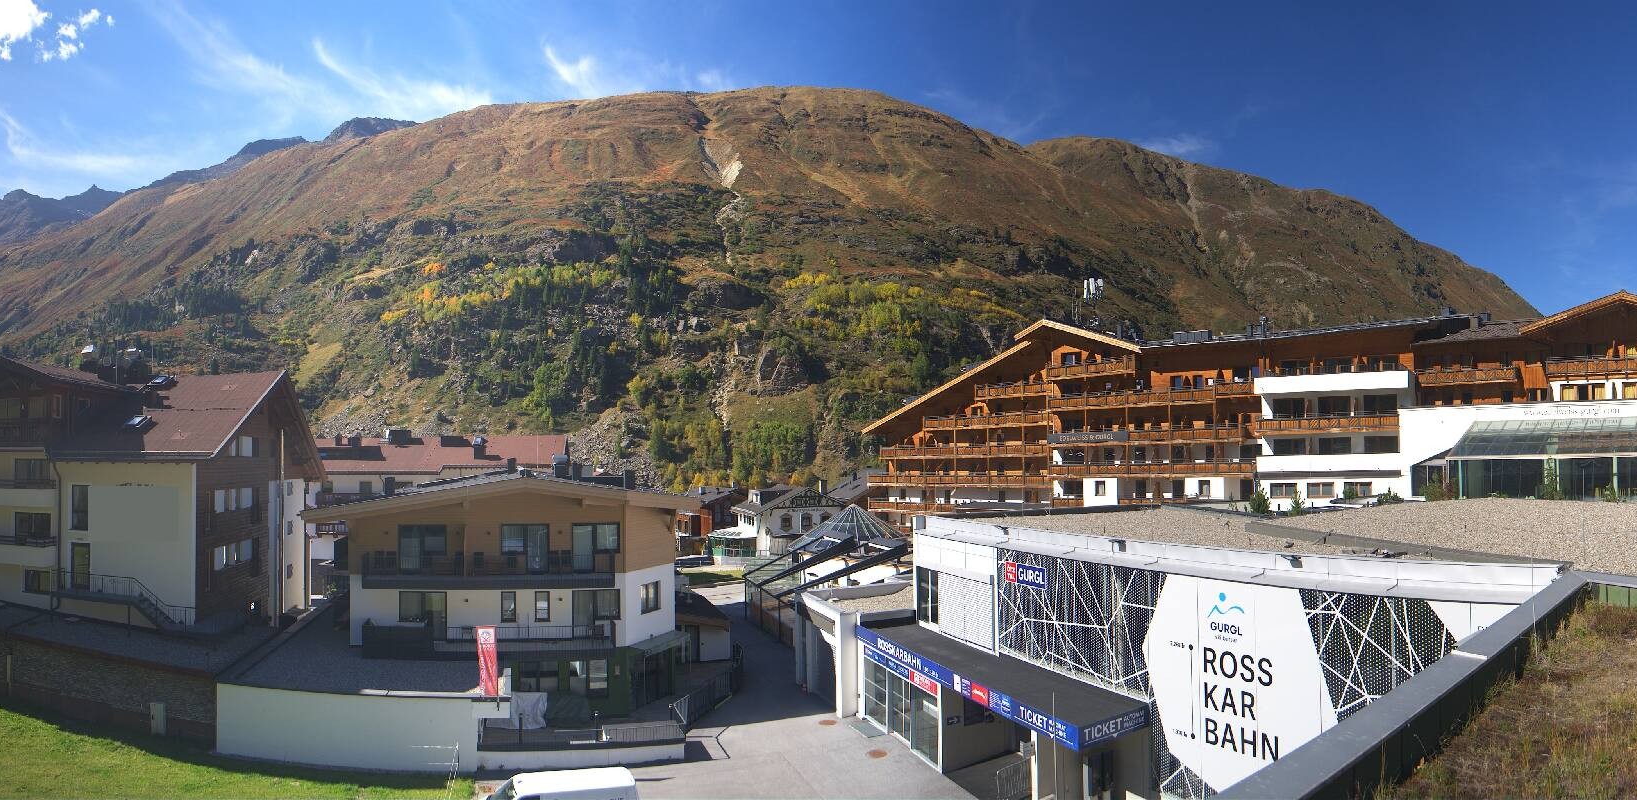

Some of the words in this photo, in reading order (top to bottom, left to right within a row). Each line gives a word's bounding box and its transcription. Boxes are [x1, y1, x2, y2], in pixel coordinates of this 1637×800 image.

[1018, 567, 1044, 585] GURGL
[1210, 621, 1243, 636] GURGL
[877, 637, 922, 671] ROSSKARBAHN
[1203, 646, 1273, 687] ROSS
[1204, 682, 1256, 721] KAR
[1019, 705, 1048, 730] TICKET
[1083, 717, 1123, 741] TICKET
[1204, 717, 1279, 762] BAHN
